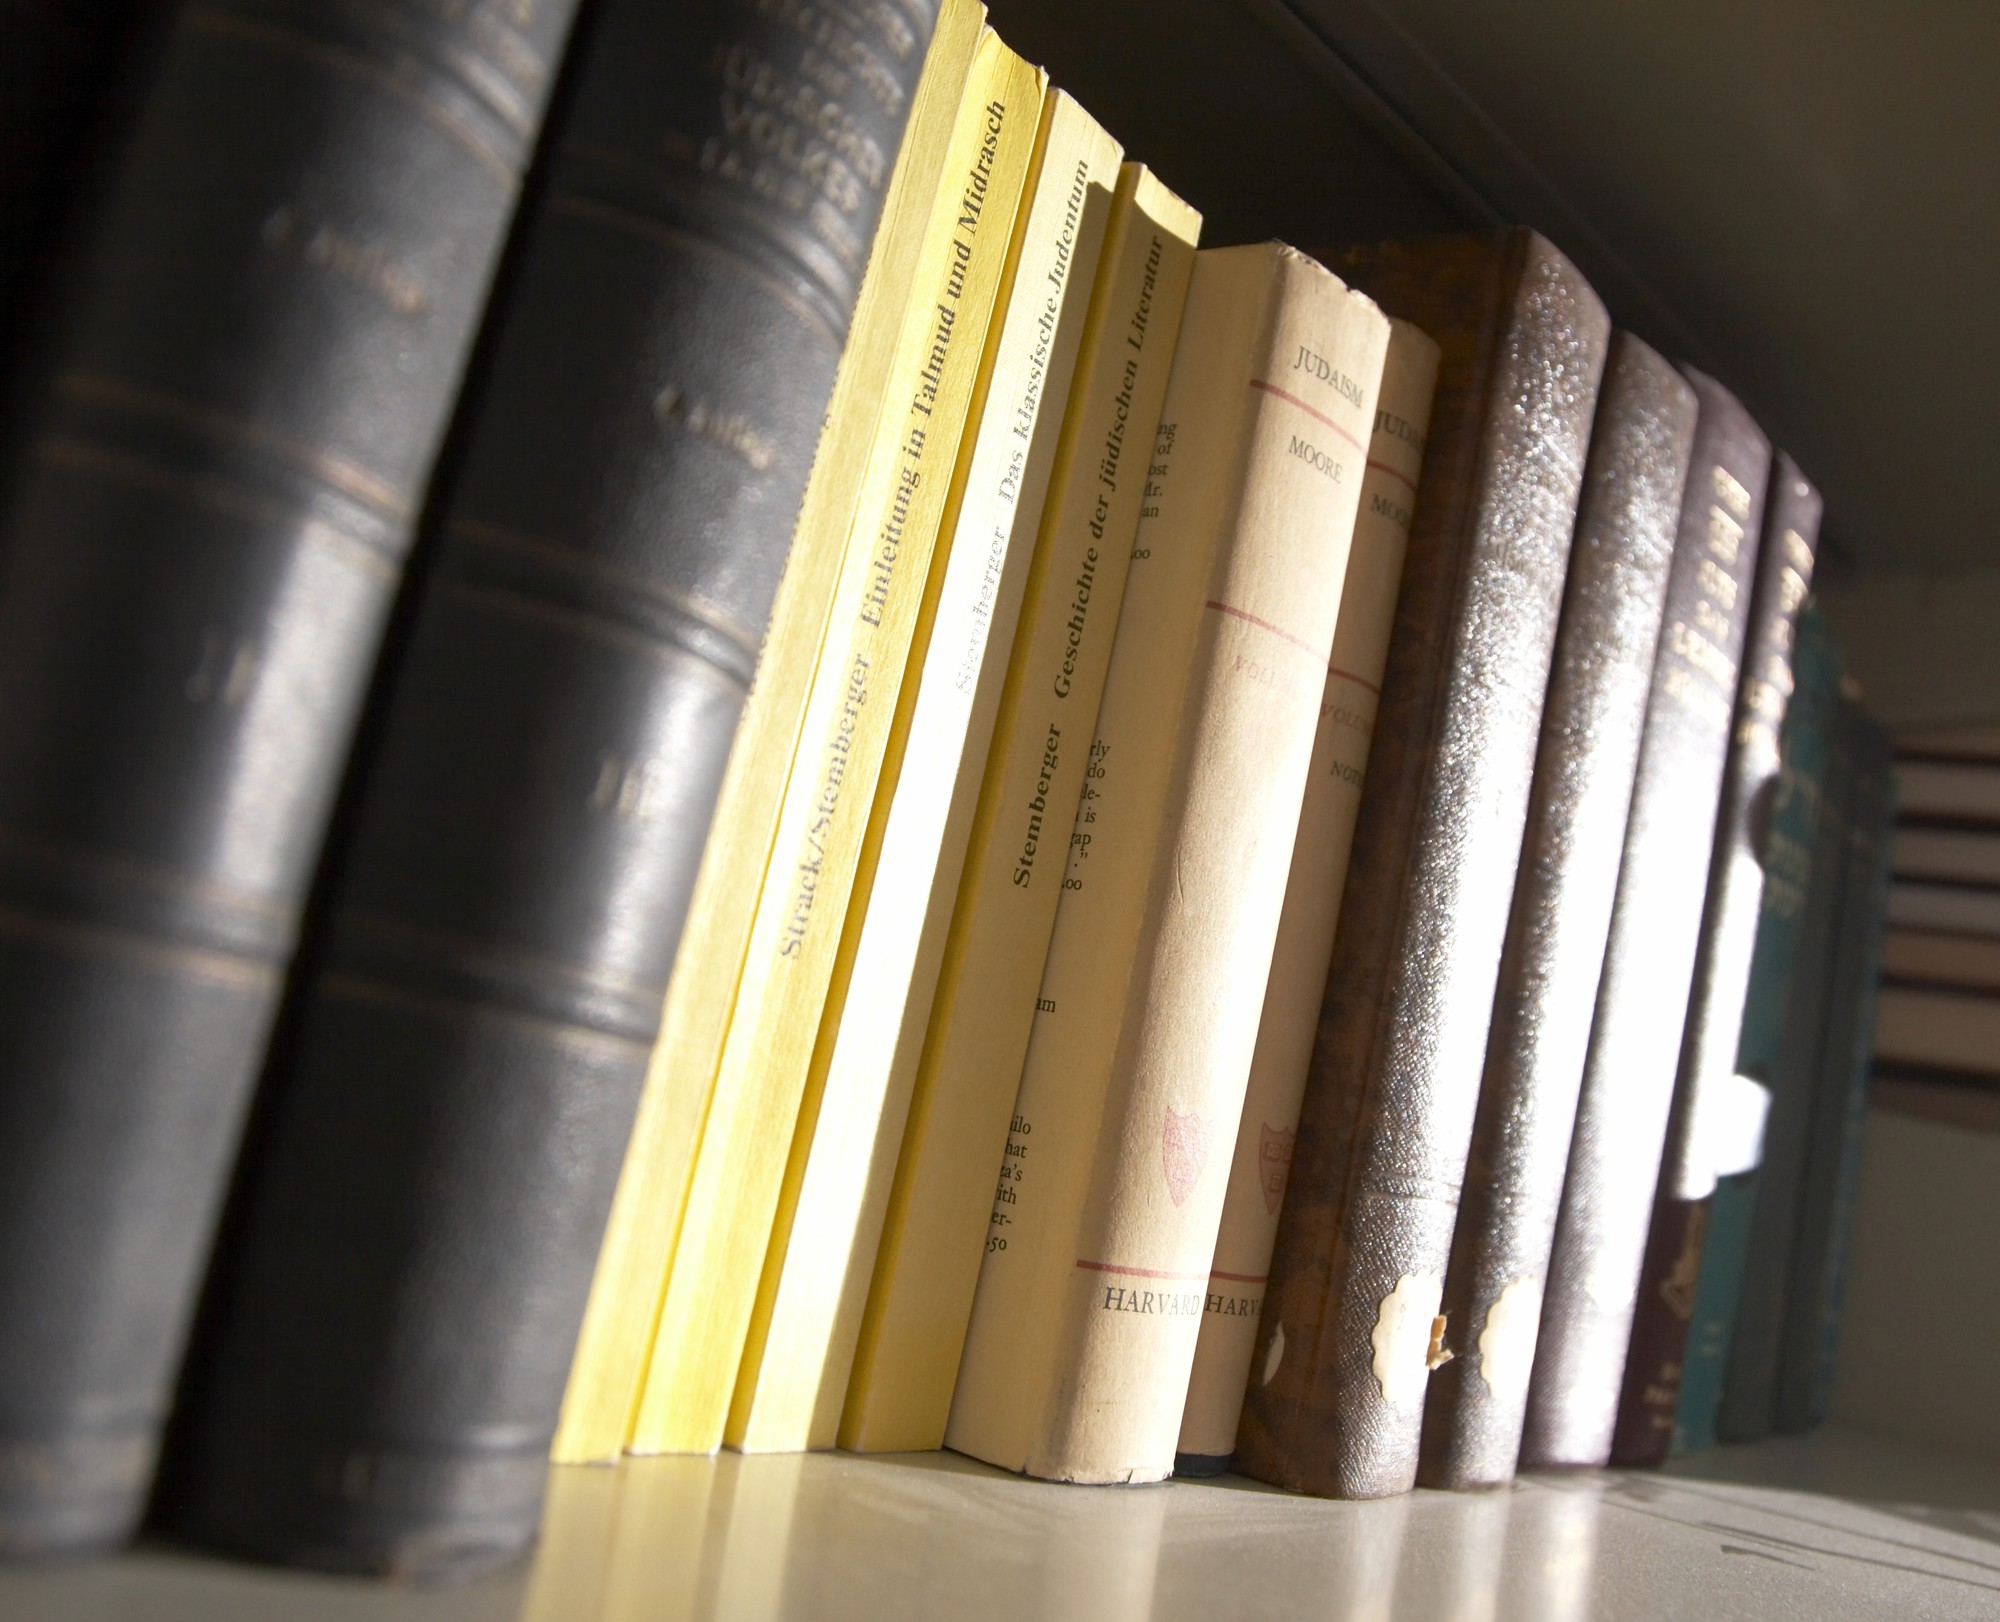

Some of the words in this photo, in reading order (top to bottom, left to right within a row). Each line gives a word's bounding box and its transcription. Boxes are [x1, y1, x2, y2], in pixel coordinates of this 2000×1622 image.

[958, 100, 1005, 236] Midrasch
[947, 239, 971, 299] und
[911, 303, 956, 416] Talmud
[998, 450, 1024, 504] Das
[1013, 297, 1057, 440] klassische
[1048, 159, 1088, 294] Judentum
[1294, 345, 1364, 408] JUDAISM
[903, 429, 926, 459] in
[1288, 435, 1343, 484] MOORE
[861, 467, 921, 628] Einleitung
[1013, 723, 1061, 888] Stemberger
[1054, 546, 1098, 700] Geschichte
[1087, 495, 1109, 540] der
[1098, 359, 1138, 492] jüdischen
[1127, 235, 1163, 352] Literatur
[782, 653, 870, 960] Strack/Stemberger
[1102, 1286, 1200, 1315] HARVARD
